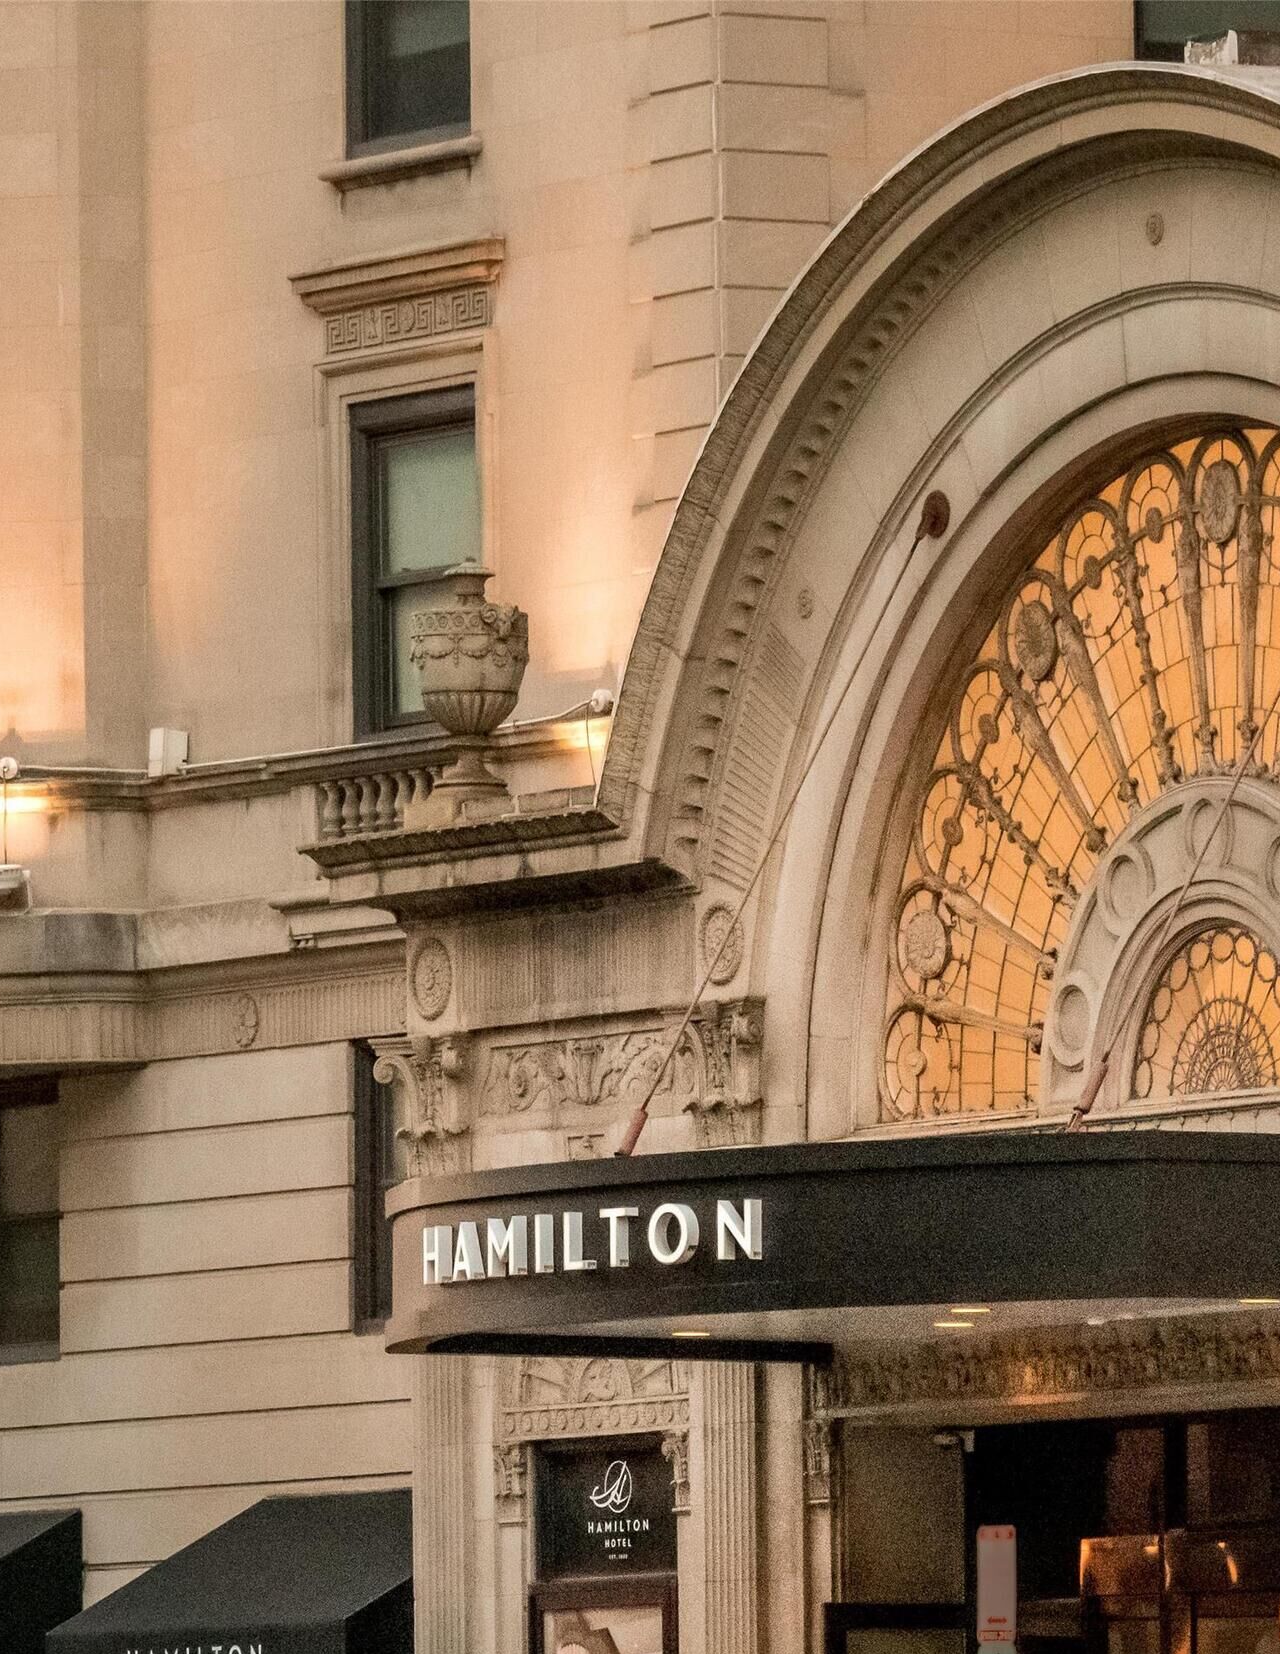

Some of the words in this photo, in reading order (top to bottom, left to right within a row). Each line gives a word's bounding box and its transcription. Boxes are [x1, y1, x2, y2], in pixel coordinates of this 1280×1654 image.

[422, 1199, 762, 1285] HAMILTON
[587, 1519, 649, 1533] HAMILTON
[605, 1539, 632, 1548] HOTEL
